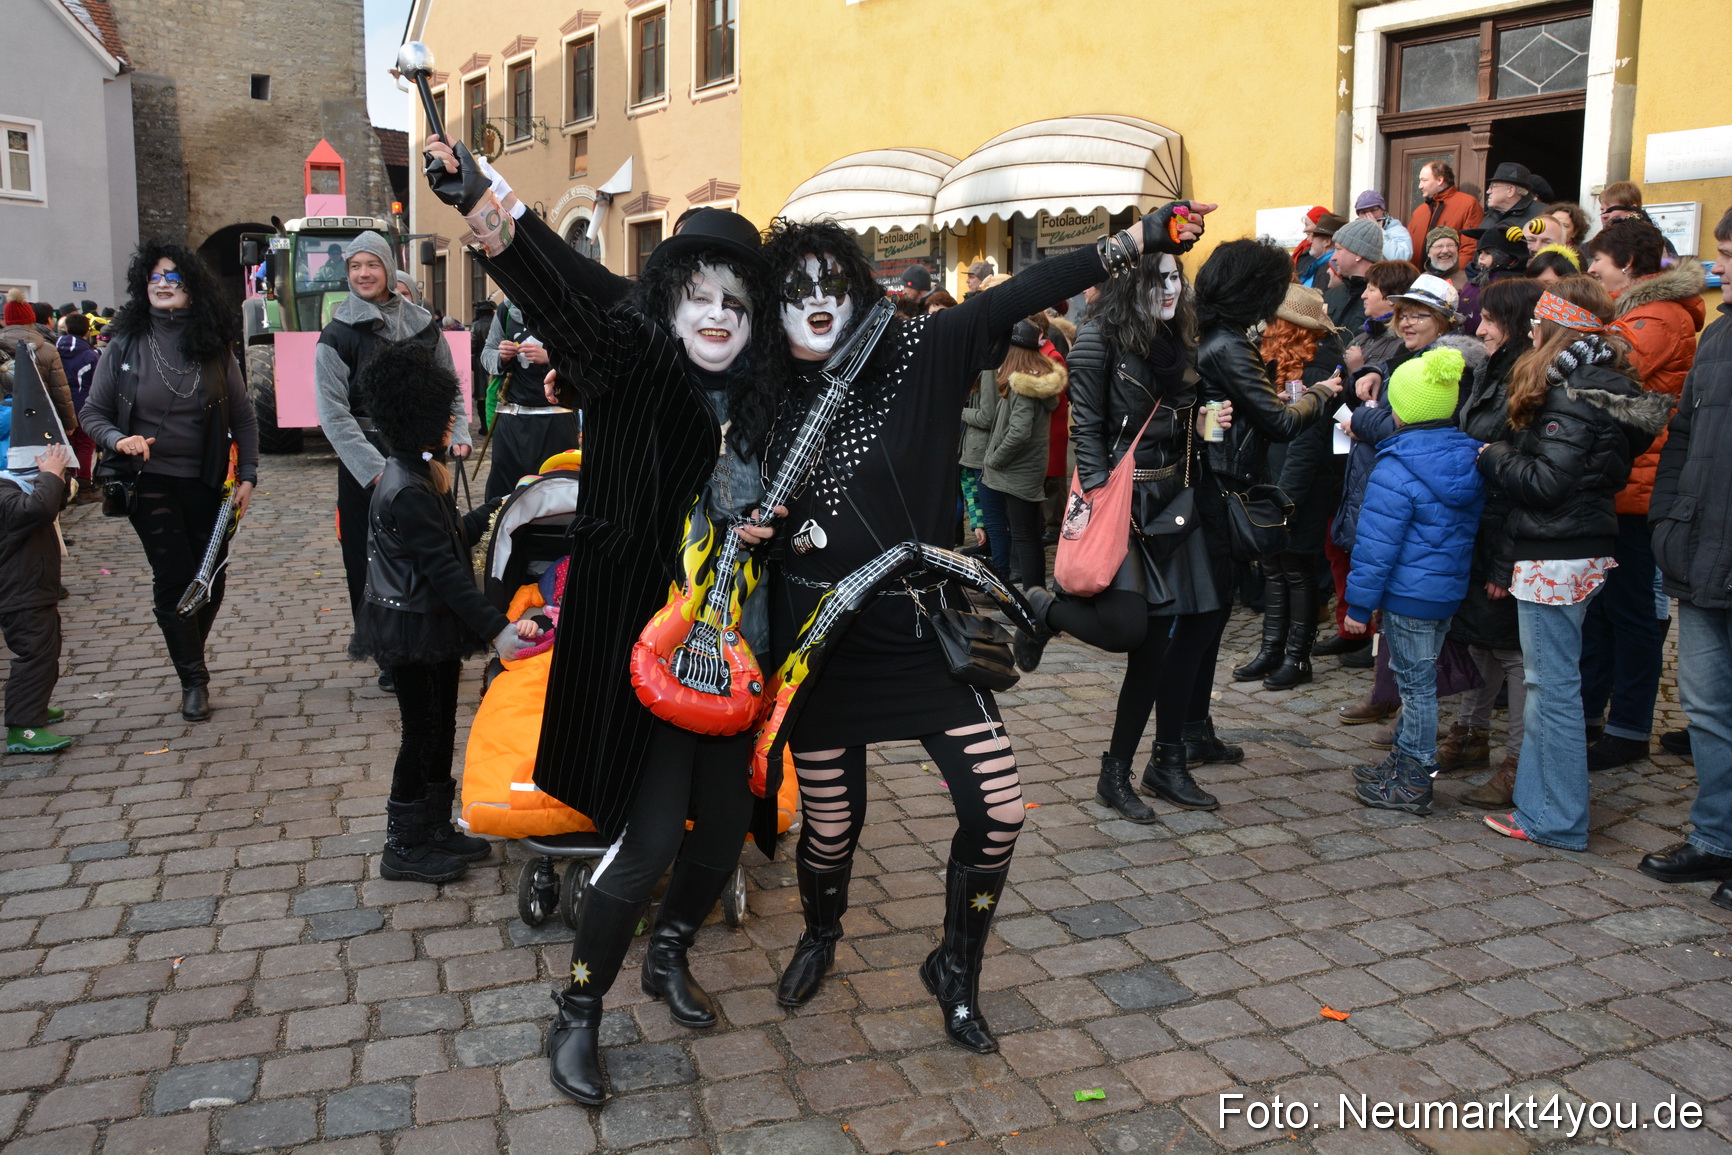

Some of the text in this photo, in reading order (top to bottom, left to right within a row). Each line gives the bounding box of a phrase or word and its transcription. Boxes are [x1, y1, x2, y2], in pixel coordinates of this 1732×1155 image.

[1042, 214, 1095, 228] Fotoladen
[879, 231, 919, 244] Fotoladen
[1048, 222, 1105, 245] Christine
[884, 237, 928, 258] Christine
